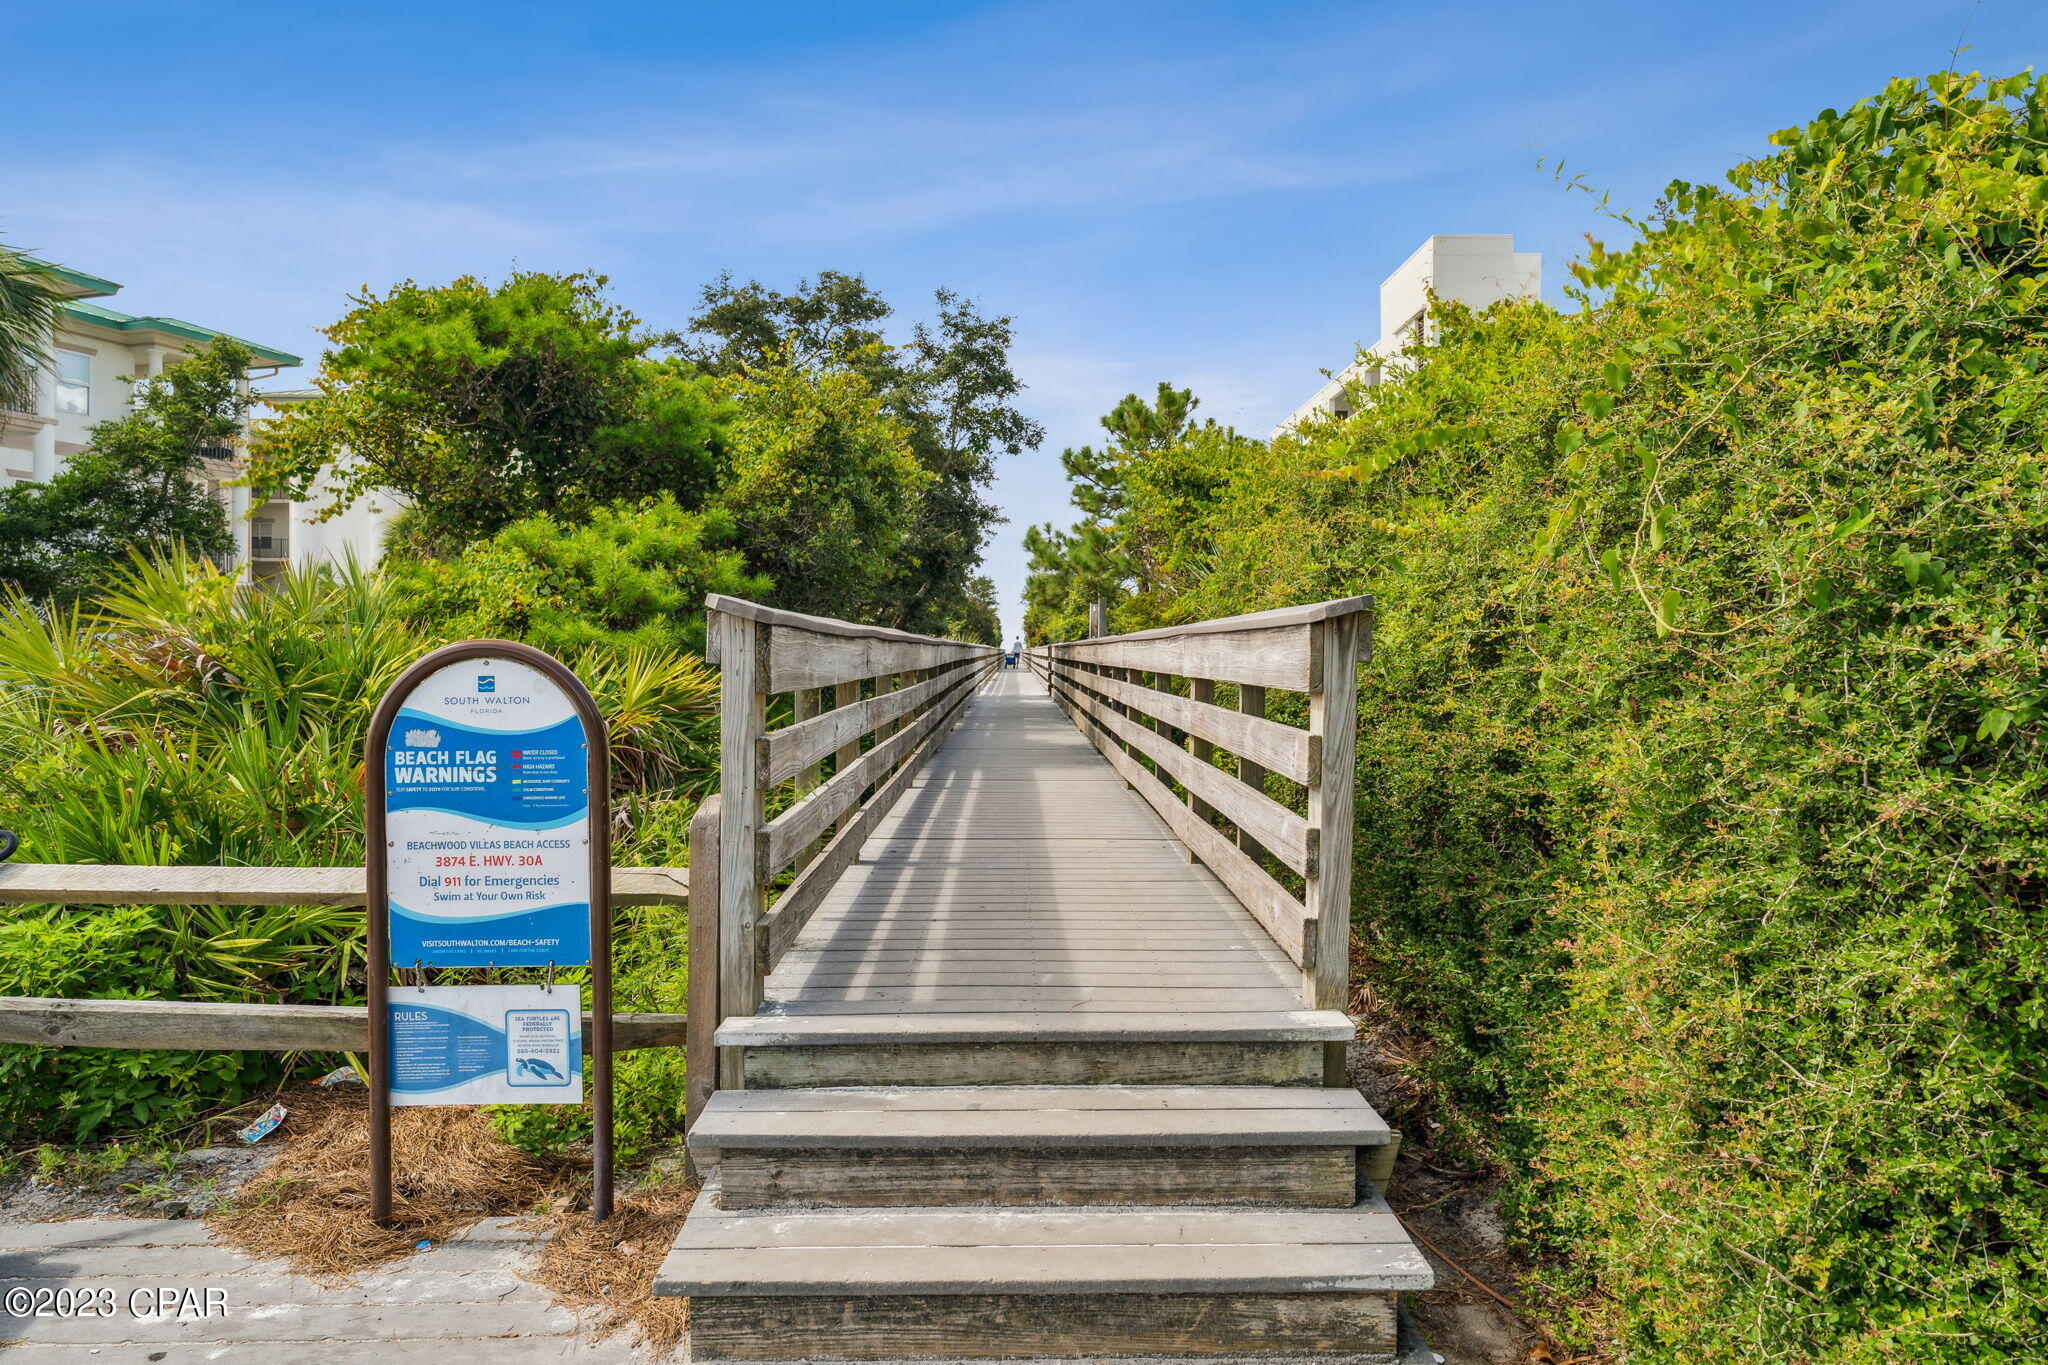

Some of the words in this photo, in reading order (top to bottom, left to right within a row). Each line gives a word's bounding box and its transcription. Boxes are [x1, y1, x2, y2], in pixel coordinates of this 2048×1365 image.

[444, 697, 479, 705] SOUTH
[485, 697, 530, 705] WALTON
[395, 751, 449, 766] BEACH
[456, 750, 497, 765] FLAG
[394, 767, 497, 784] WARNINGS
[407, 841, 467, 850] BEACHWOOD
[470, 841, 501, 849] VILLAS
[504, 840, 534, 849] BEACH
[536, 840, 570, 849] ACCESS
[435, 857, 465, 867] 3874
[469, 856, 479, 867] E.
[484, 856, 514, 866] HWY.
[518, 856, 543, 866] 30A
[419, 876, 441, 887] Dial
[444, 876, 461, 886] 911
[464, 876, 481, 886] for
[484, 875, 559, 889] Emergencies
[434, 892, 461, 901] Swim
[464, 893, 473, 901] at
[476, 892, 498, 901] Your
[500, 892, 523, 901] Own
[526, 891, 546, 900] Risk
[422, 938, 560, 947] VISITSOUTHWALTON.COM/BEACH-SAFETY
[394, 1012, 428, 1021] RULES
